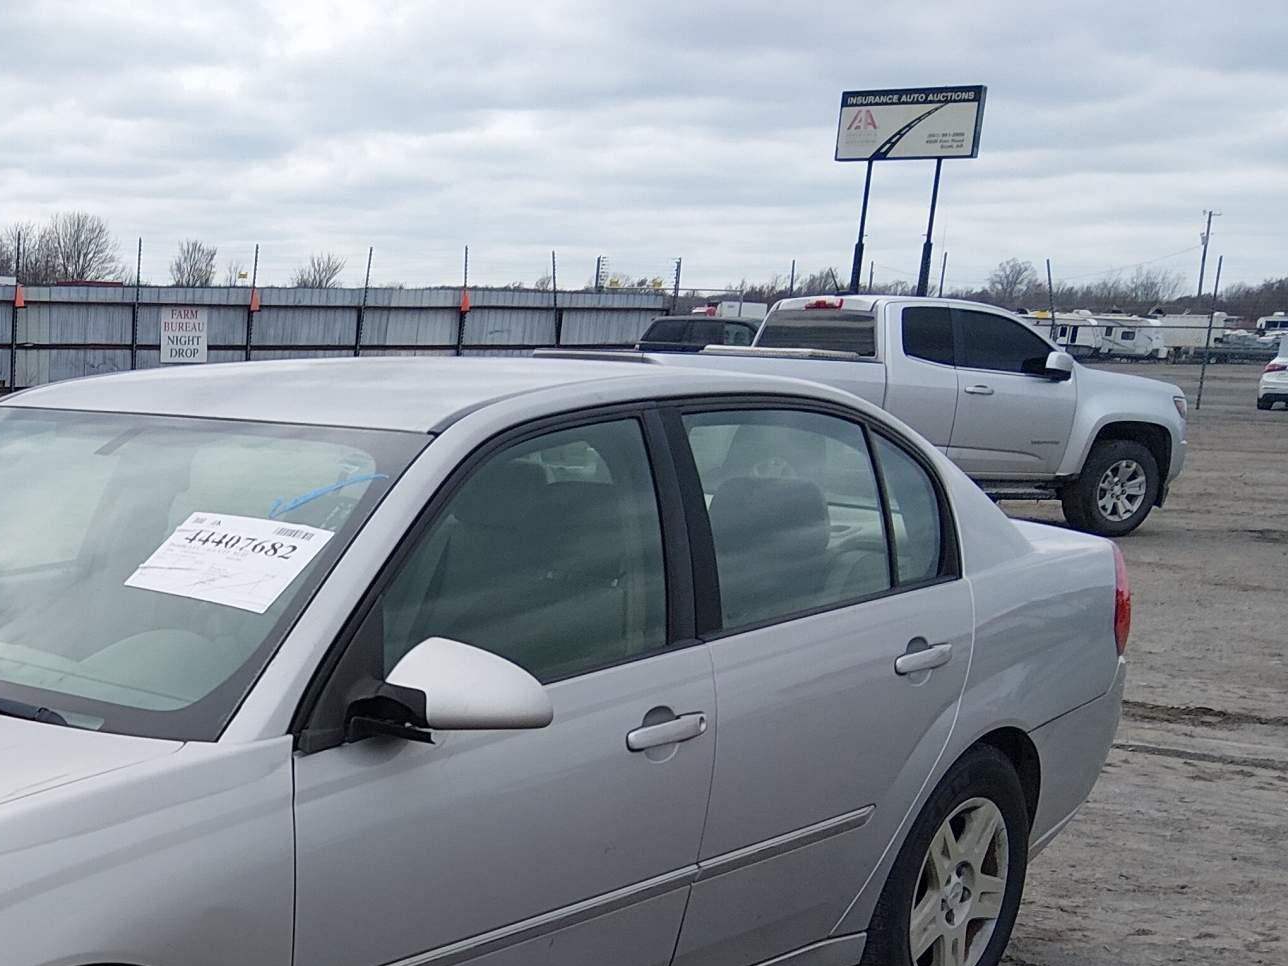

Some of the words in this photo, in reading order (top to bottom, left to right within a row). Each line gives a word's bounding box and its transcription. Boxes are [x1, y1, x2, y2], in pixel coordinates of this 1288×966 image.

[847, 94, 899, 105] INSURANCE
[900, 93, 926, 103] AUTO
[927, 91, 975, 102] AUCTIONS
[171, 309, 199, 320] FARM
[164, 321, 205, 333] BUREAU
[167, 335, 202, 346] NIGHT
[170, 347, 199, 359] DROP
[184, 529, 299, 561] 44407682
